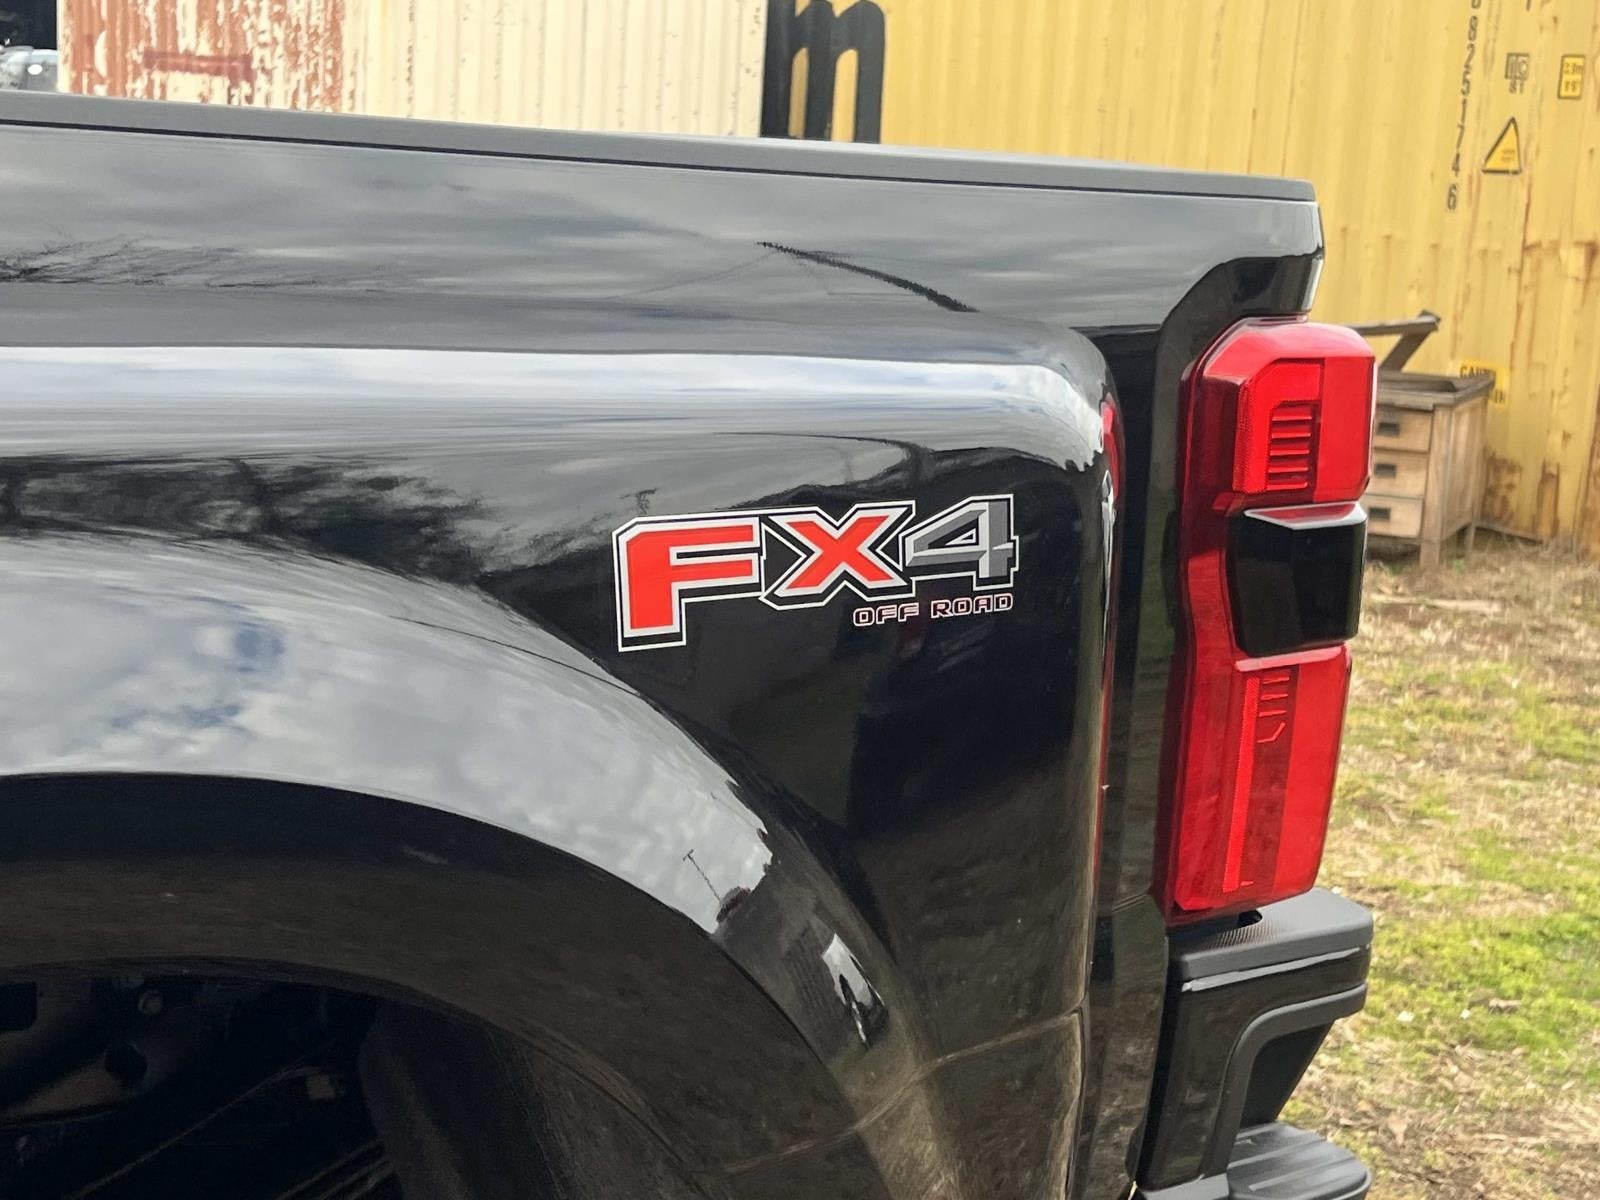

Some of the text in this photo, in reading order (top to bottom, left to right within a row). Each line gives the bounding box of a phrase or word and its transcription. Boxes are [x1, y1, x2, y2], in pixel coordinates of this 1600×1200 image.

[611, 494, 1020, 652] FX4
[853, 593, 1014, 627] OFF ROAD
